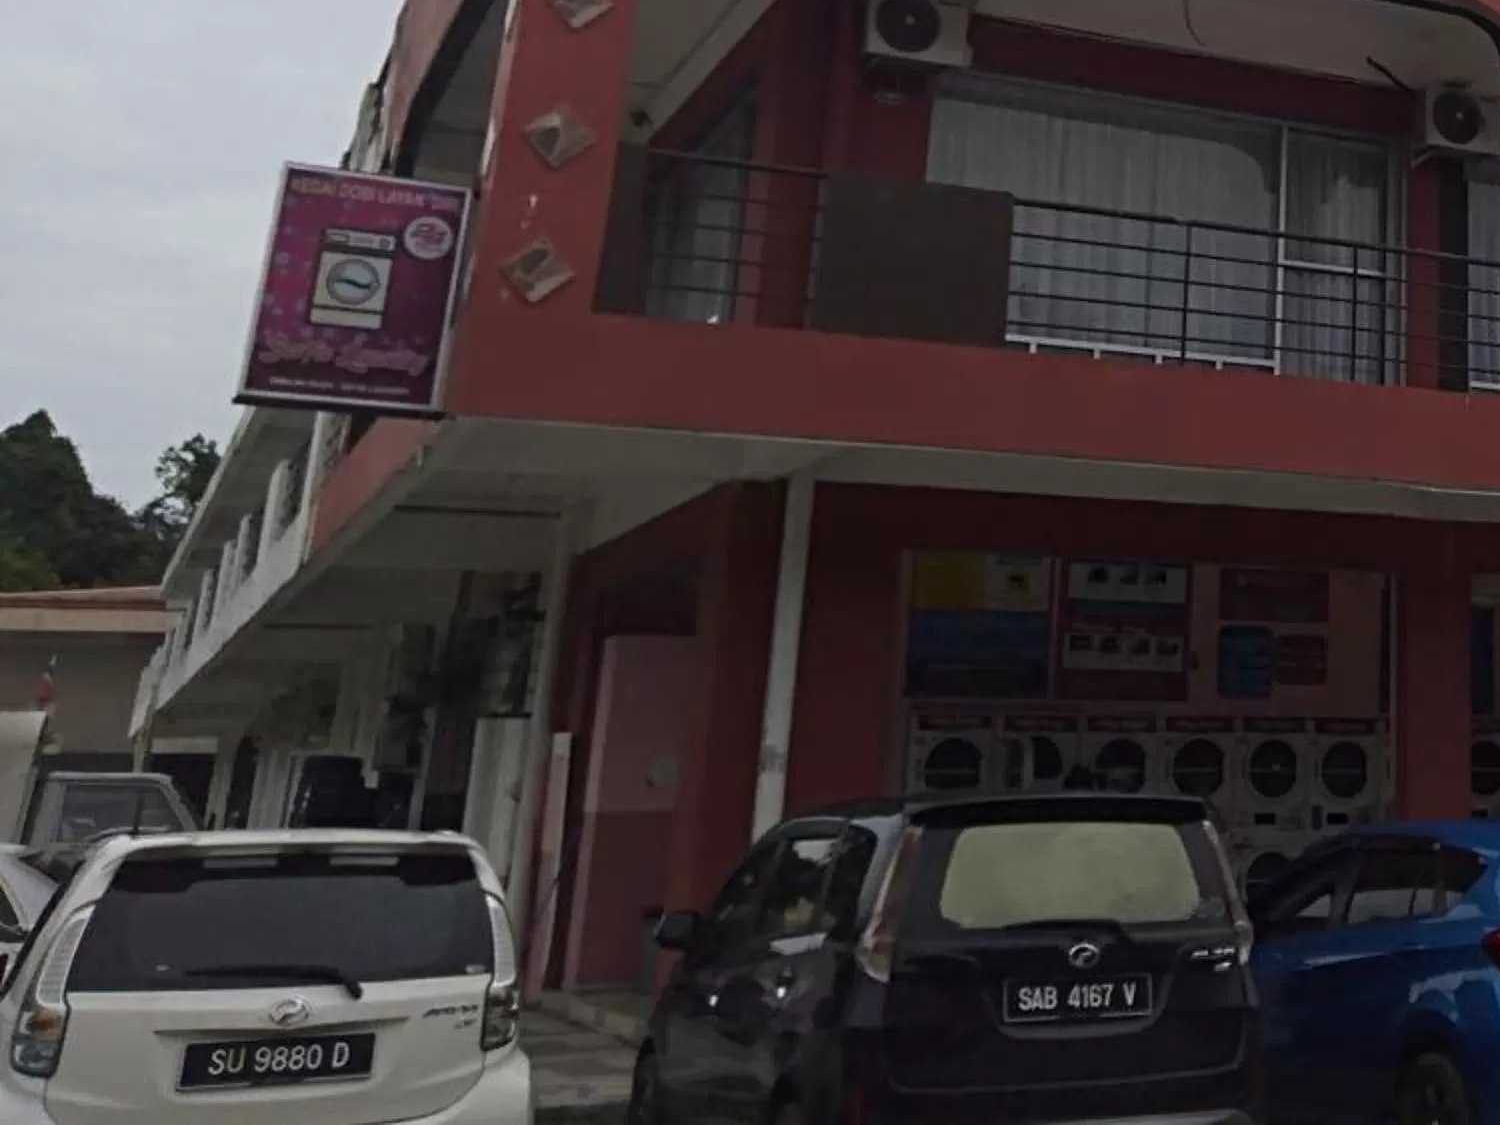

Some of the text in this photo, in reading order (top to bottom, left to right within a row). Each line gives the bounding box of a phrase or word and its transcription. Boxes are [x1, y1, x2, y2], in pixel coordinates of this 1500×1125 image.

[1018, 980, 1138, 1012] SAB 4167 V
[207, 1041, 350, 1075] SU 9880 D
